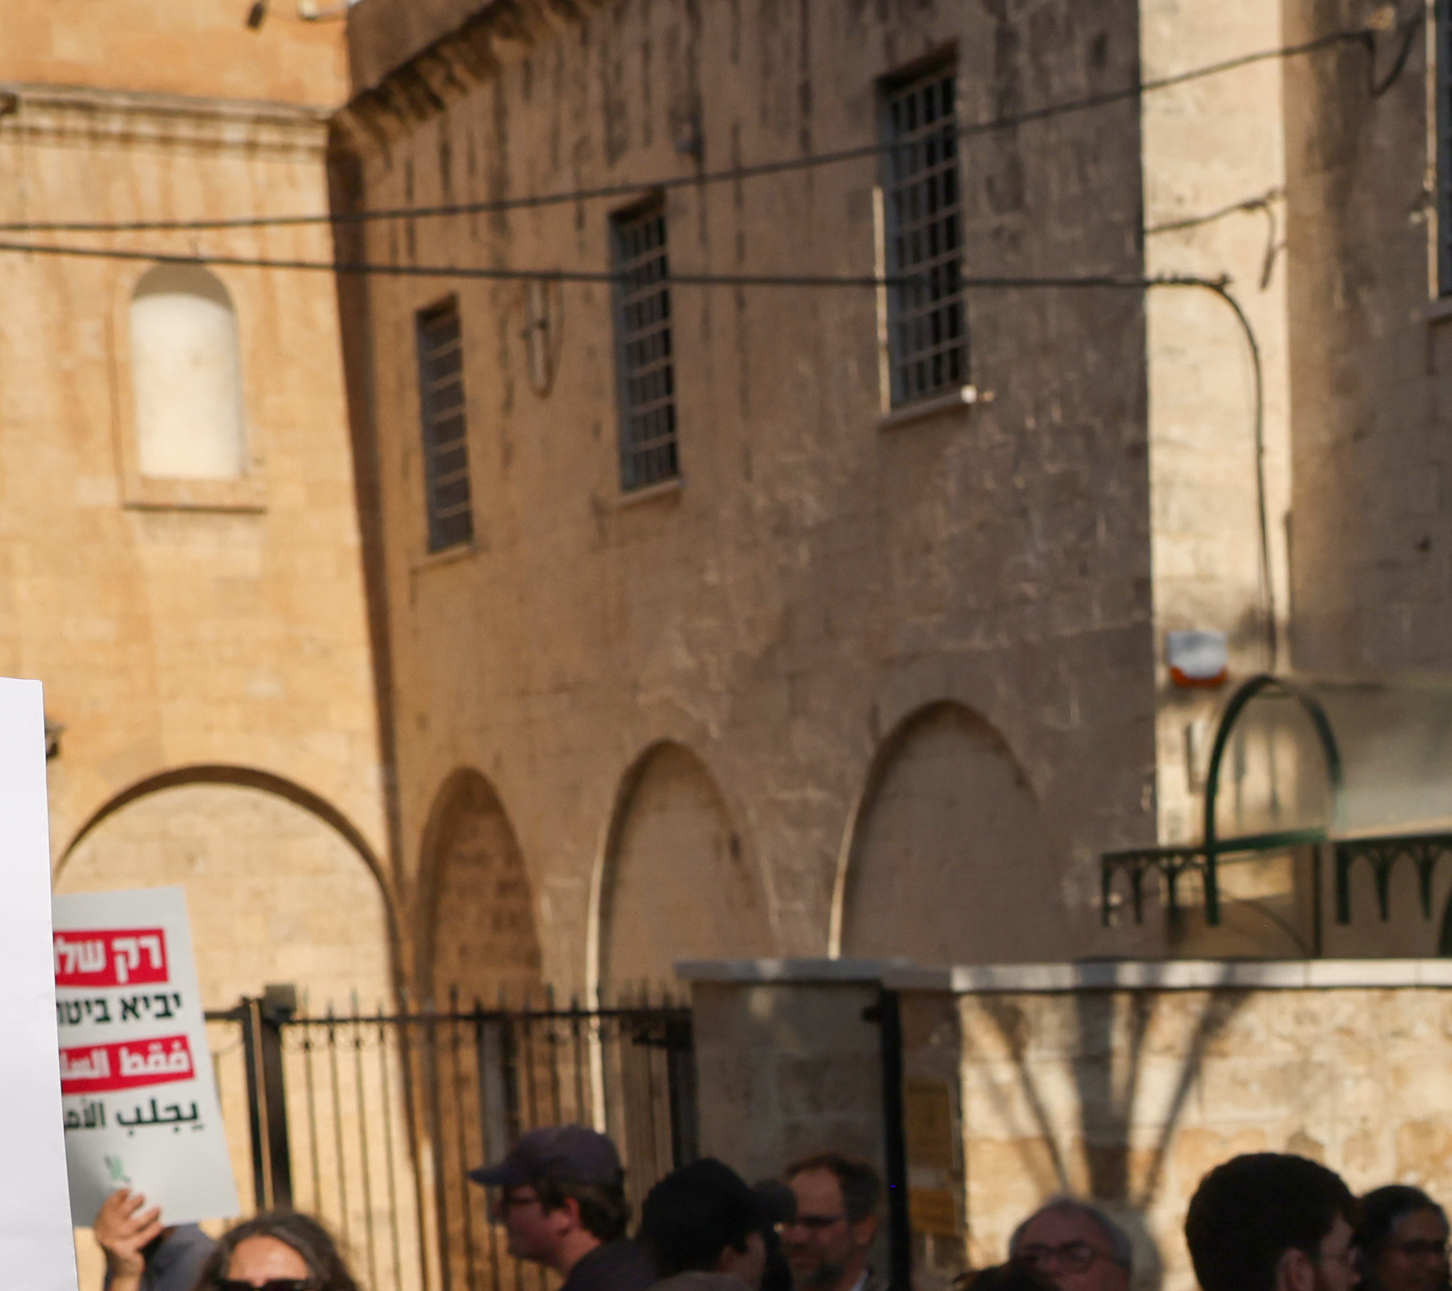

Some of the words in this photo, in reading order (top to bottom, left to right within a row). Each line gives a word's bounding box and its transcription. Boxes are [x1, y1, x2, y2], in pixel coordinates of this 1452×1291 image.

[53, 936, 106, 974] שלו
[112, 935, 163, 985] רק
[120, 993, 182, 1022] יביא
[118, 1039, 191, 1078] فقط
[116, 1097, 204, 1137] يجلب
